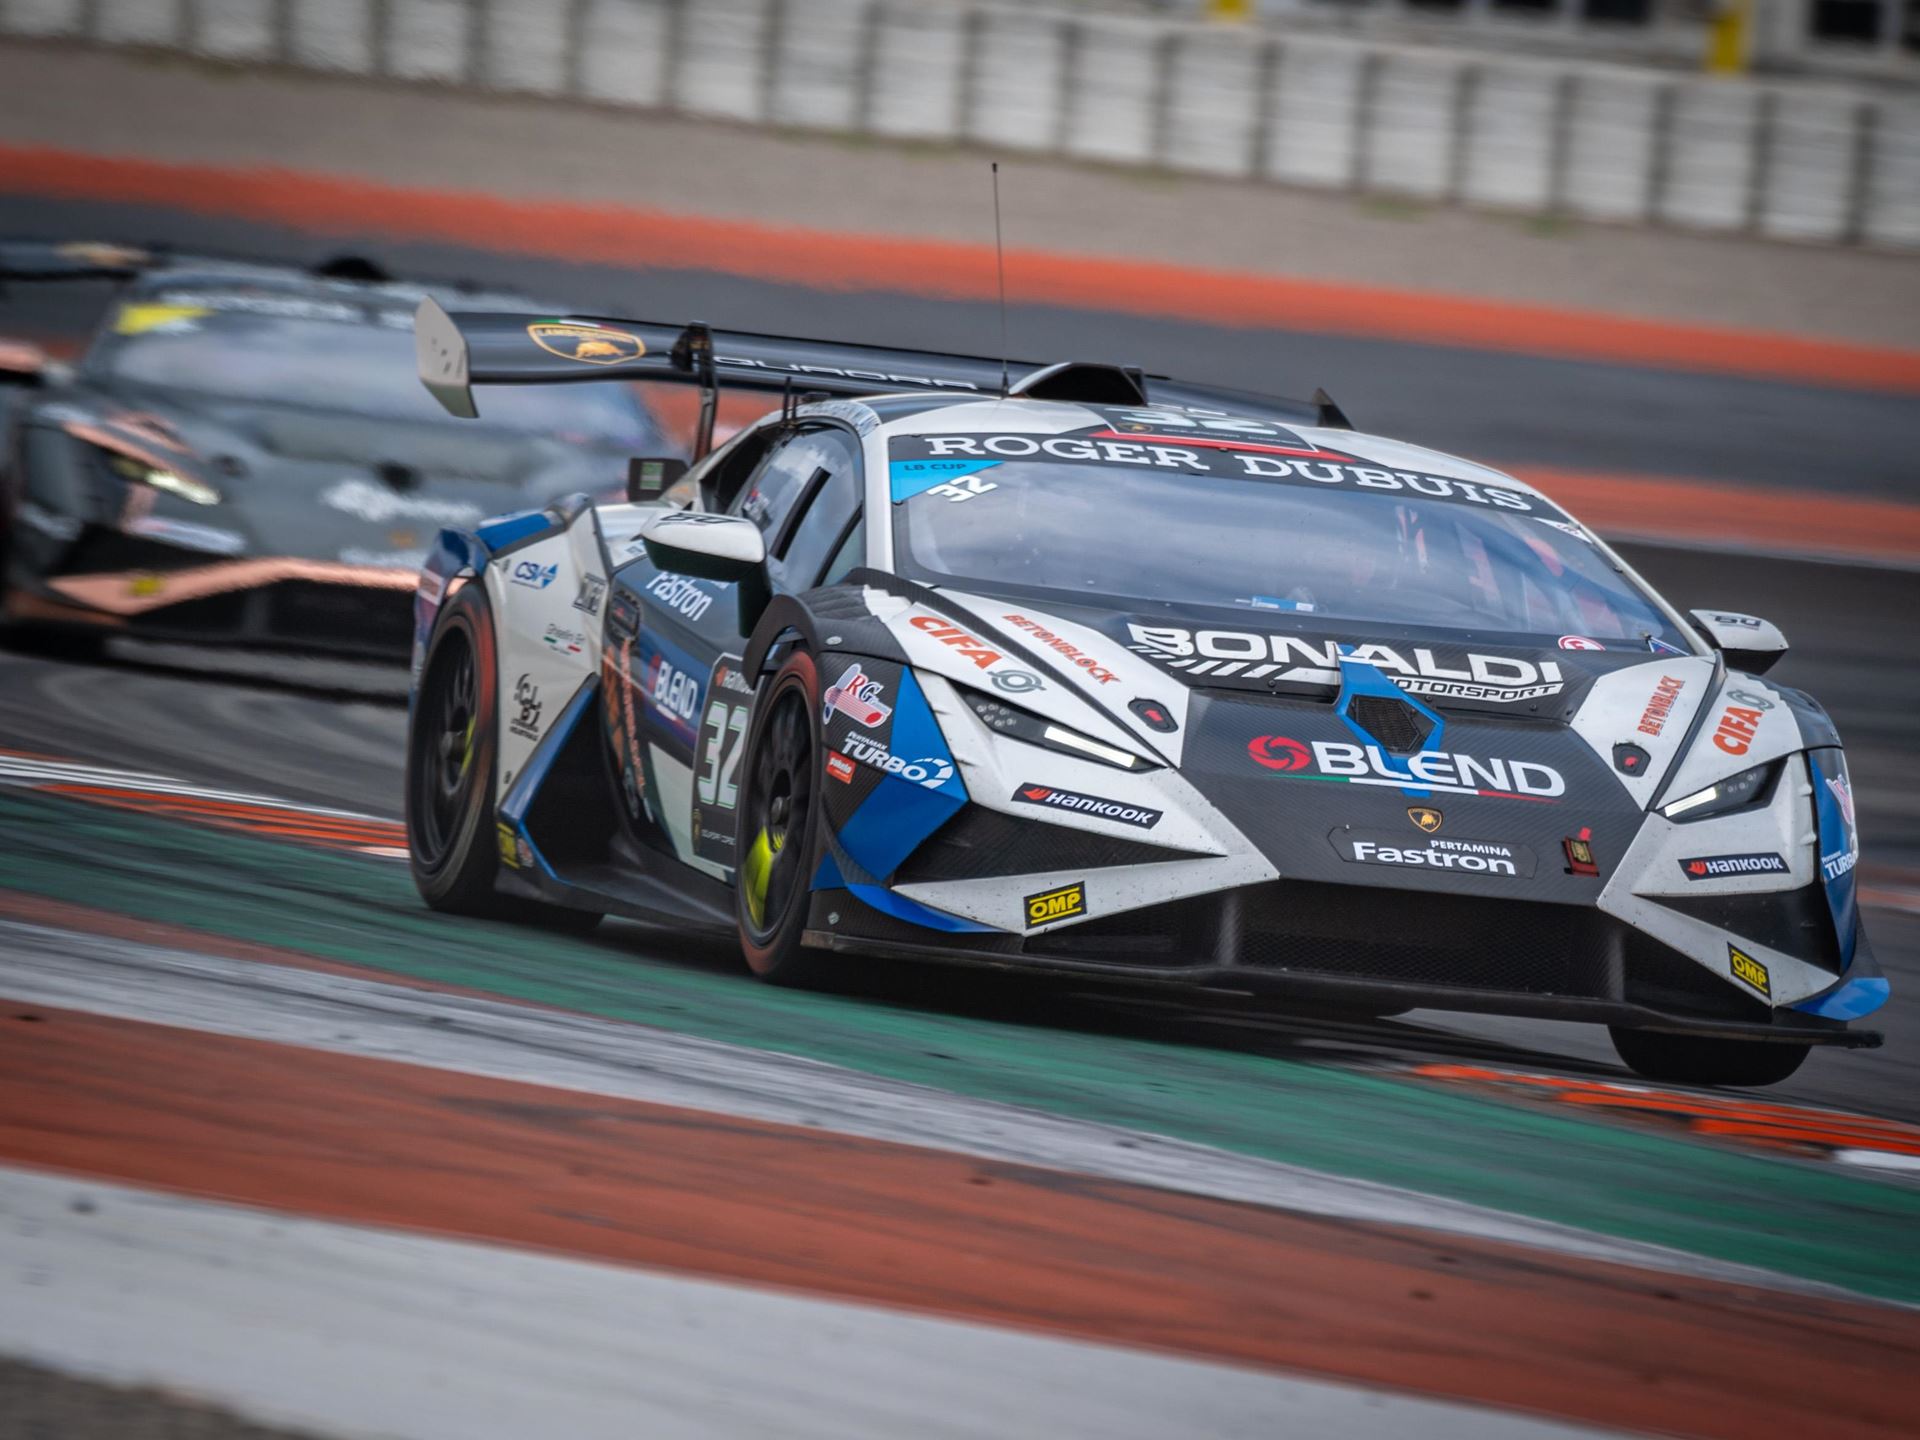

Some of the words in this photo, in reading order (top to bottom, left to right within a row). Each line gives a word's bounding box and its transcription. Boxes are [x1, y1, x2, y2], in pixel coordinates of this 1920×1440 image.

[924, 436, 1210, 471] ROGER
[1233, 453, 1532, 513] DUBUIS
[926, 475, 999, 503] 32
[930, 463, 967, 471] CUP
[909, 616, 1003, 670] CIFA
[1002, 614, 1121, 686] BETONBLOCK
[1126, 622, 1564, 686] BONALDI
[654, 660, 699, 719] BLEND
[1390, 677, 1558, 701] OTORSPORT
[1637, 675, 1685, 737] BETONBLOCK
[698, 701, 749, 809] 32
[1712, 706, 1763, 756] CIFA
[842, 737, 928, 780] TURBO
[1311, 741, 1566, 797] BLEND
[1354, 842, 1516, 875] Fastron
[1430, 839, 1511, 858] PERTAMINA
[1030, 892, 1081, 918] OMP
[1732, 953, 1768, 985] OMP
